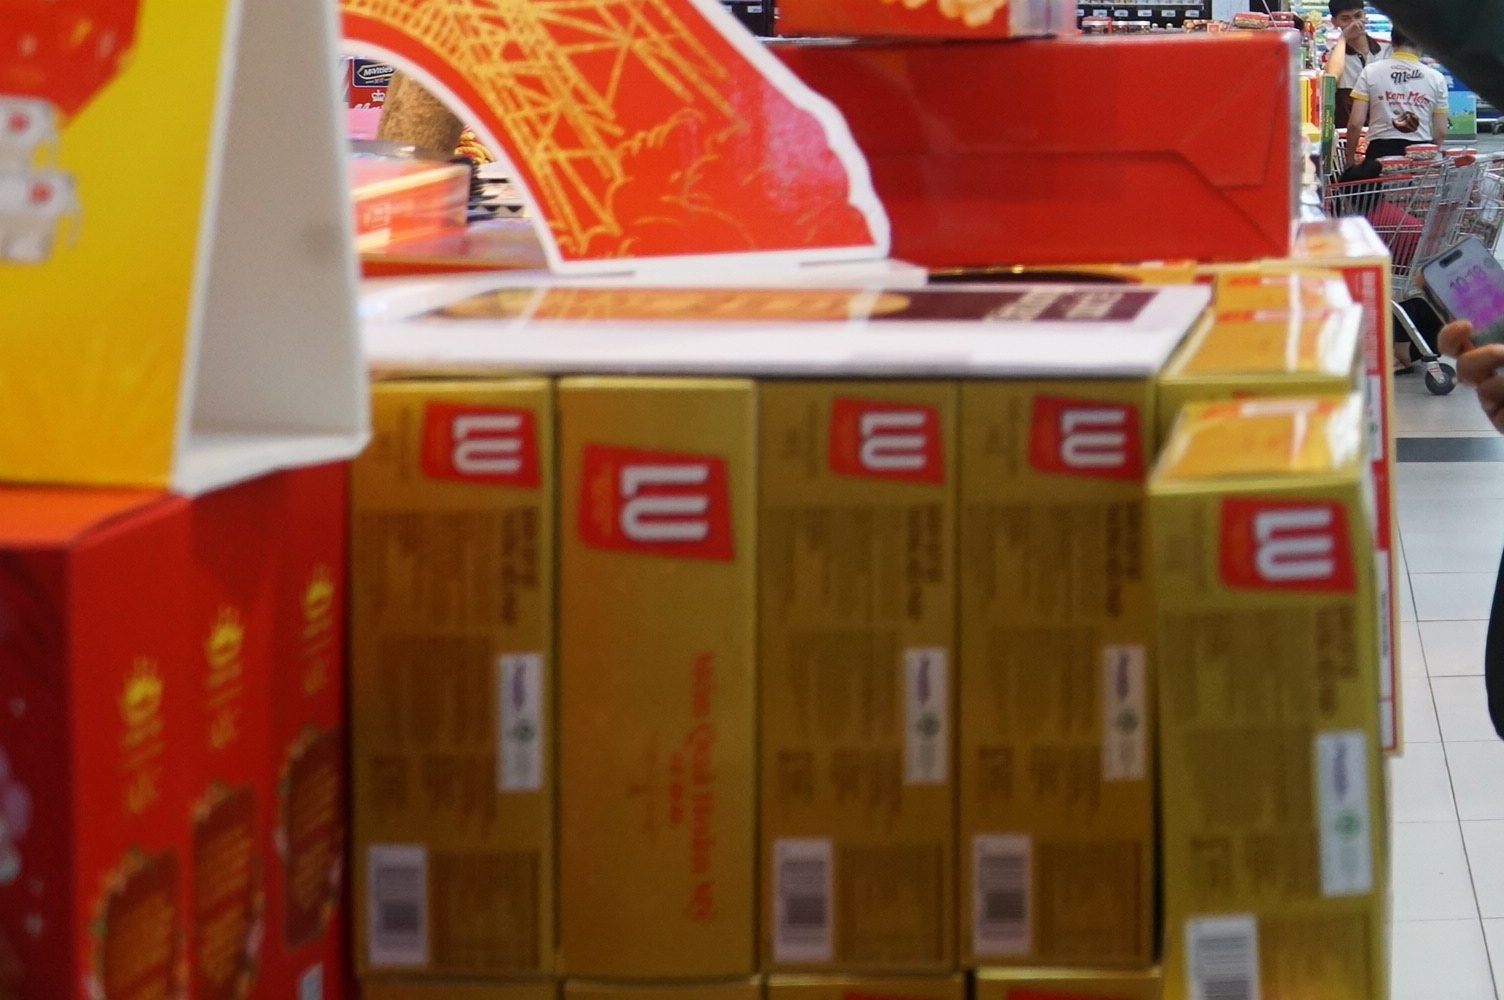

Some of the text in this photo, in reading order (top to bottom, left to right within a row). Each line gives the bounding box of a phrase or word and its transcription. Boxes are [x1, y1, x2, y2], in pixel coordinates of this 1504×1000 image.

[450, 411, 525, 475] LU
[856, 409, 929, 473] LU
[1058, 406, 1130, 470] LU
[618, 463, 712, 542] LU
[1253, 506, 1338, 582] LU
